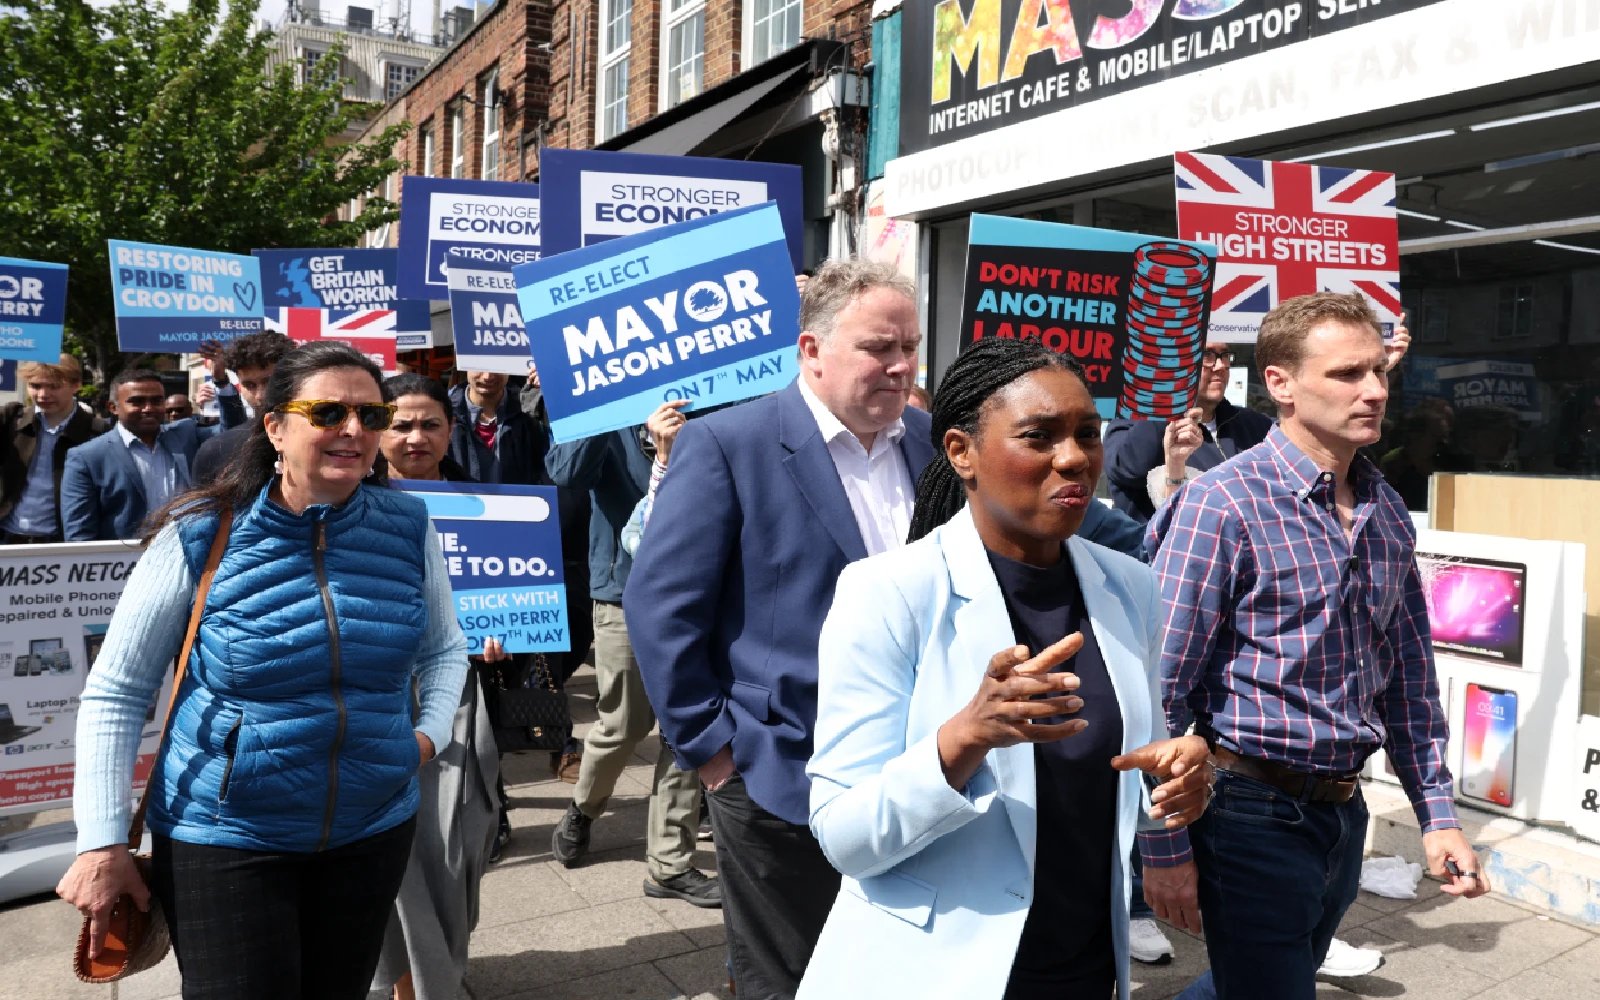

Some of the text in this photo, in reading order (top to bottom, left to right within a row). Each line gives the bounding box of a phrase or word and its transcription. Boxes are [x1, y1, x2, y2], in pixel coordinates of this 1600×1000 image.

[929, 89, 1014, 134] INTERNET
[1018, 72, 1070, 108] CAFE
[1075, 66, 1092, 92] &
[1099, 3, 1302, 86] MOBILE/LAPTOP
[611, 184, 740, 206] STRONGER
[595, 202, 719, 225] ECONO
[1235, 211, 1348, 238] STRONGER
[115, 246, 242, 277] RESTORING
[1271, 237, 1387, 266] STREETS
[309, 255, 344, 272] GET
[119, 268, 215, 294] PRIDE IN
[311, 269, 385, 289] BRITAIN
[549, 255, 650, 307] RE-ELECT
[979, 261, 1121, 296] DON'T RISK
[121, 288, 235, 314] CROYDON
[976, 288, 1117, 325] ANOTHER
[220, 320, 261, 330] RE-ELECT
[562, 269, 768, 367] MAYOR
[159, 332, 198, 343] MAYOR
[571, 310, 772, 397] JASON PERRY
[663, 382, 701, 403] ON
[735, 354, 783, 386] MAY
[467, 556, 504, 577] TO
[508, 556, 555, 577] DO.
[9, 593, 63, 606] Mobile
[460, 590, 559, 612] STICK WITH
[62, 606, 73, 618] &
[509, 609, 560, 627] PERRY
[527, 628, 564, 645] MAY
[26, 699, 68, 709] Laptop
